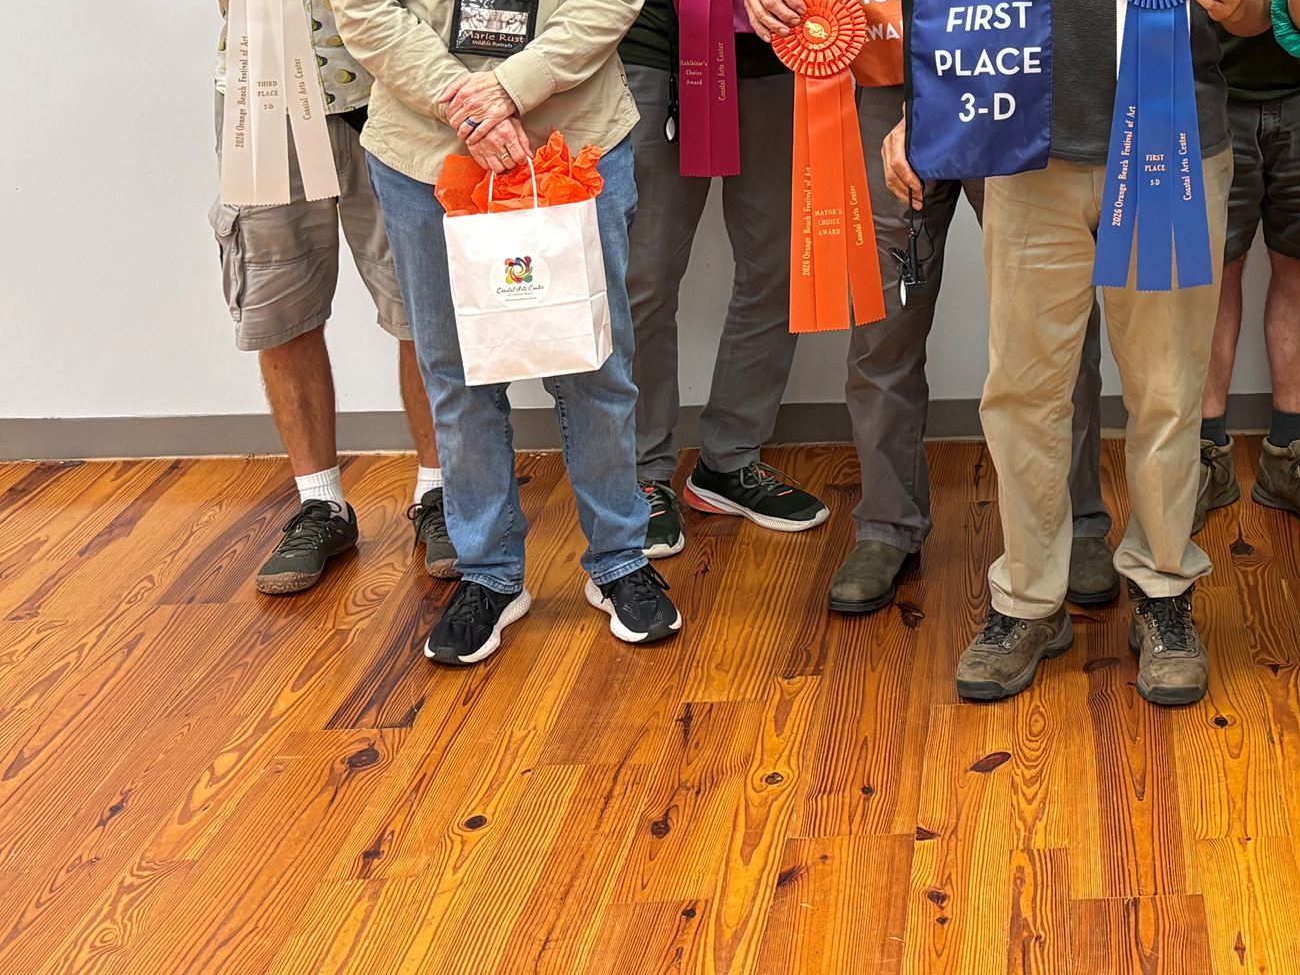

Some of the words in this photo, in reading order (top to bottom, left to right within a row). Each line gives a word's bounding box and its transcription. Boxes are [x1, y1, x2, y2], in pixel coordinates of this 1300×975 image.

[946, 1, 1032, 32] FIRST
[462, 31, 495, 41] Marie
[499, 33, 524, 43] Rust
[238, 59, 248, 83] Festival
[294, 59, 304, 79] Center
[934, 47, 1042, 76] PLACE
[238, 86, 246, 105] Beach
[299, 82, 308, 94] Arts
[718, 80, 726, 101] Coastal
[300, 98, 311, 120] Coastal
[959, 93, 1016, 122] 3-D
[1127, 106, 1136, 118] Art
[236, 109, 247, 131] Orange
[1125, 120, 1134, 128] of
[1121, 131, 1133, 156] Festival
[1179, 133, 1187, 155] Center
[1118, 160, 1128, 180] Beach
[1181, 158, 1189, 173] Arts
[850, 185, 858, 205] Center
[1115, 183, 1127, 208] Orange
[1182, 175, 1192, 201] Coastal
[803, 189, 811, 212] Festival
[803, 215, 811, 234] Beach
[1112, 209, 1122, 227] 2026
[818, 228, 840, 236] AWARD
[853, 223, 864, 246] Coastal
[803, 237, 812, 259] Orange
